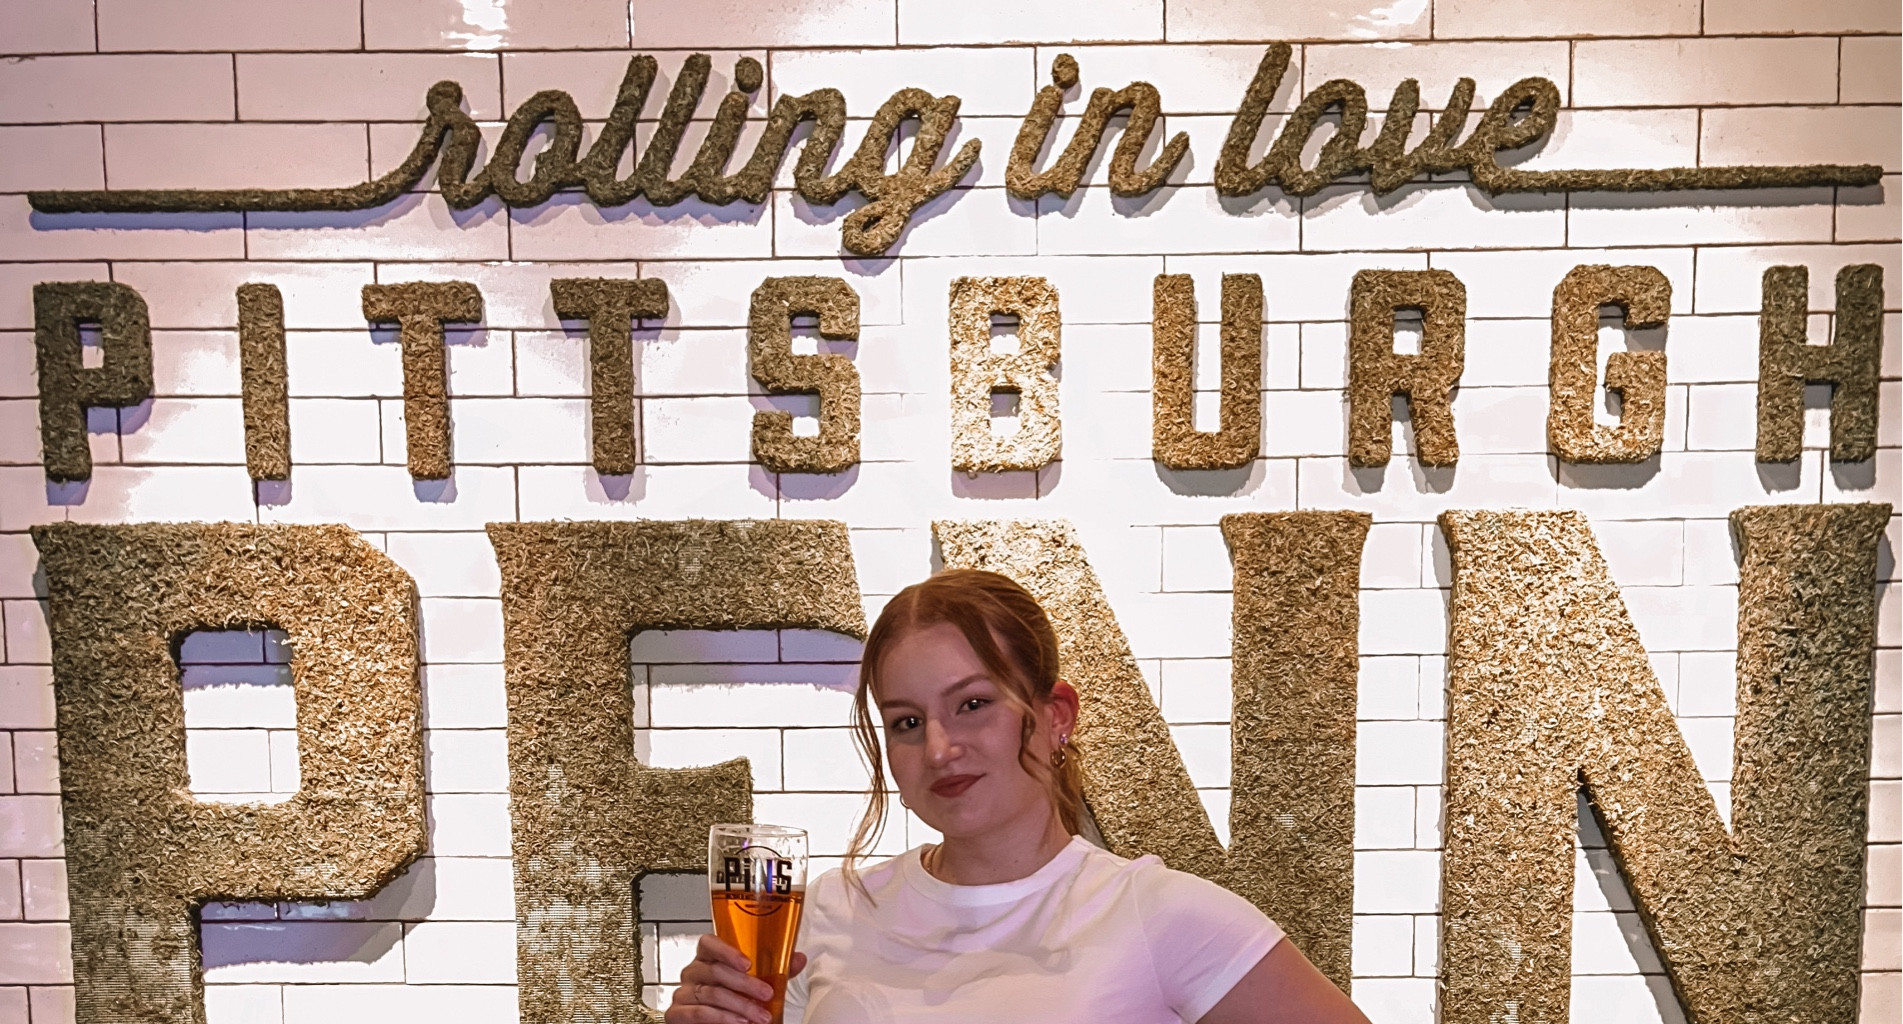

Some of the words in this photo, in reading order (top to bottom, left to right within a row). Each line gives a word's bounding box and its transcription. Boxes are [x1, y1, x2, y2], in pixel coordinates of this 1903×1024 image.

[28, 53, 982, 258] rolling
[1005, 52, 1190, 198] in
[1214, 41, 1884, 196] love
[33, 264, 1885, 482] PITTSBURGH
